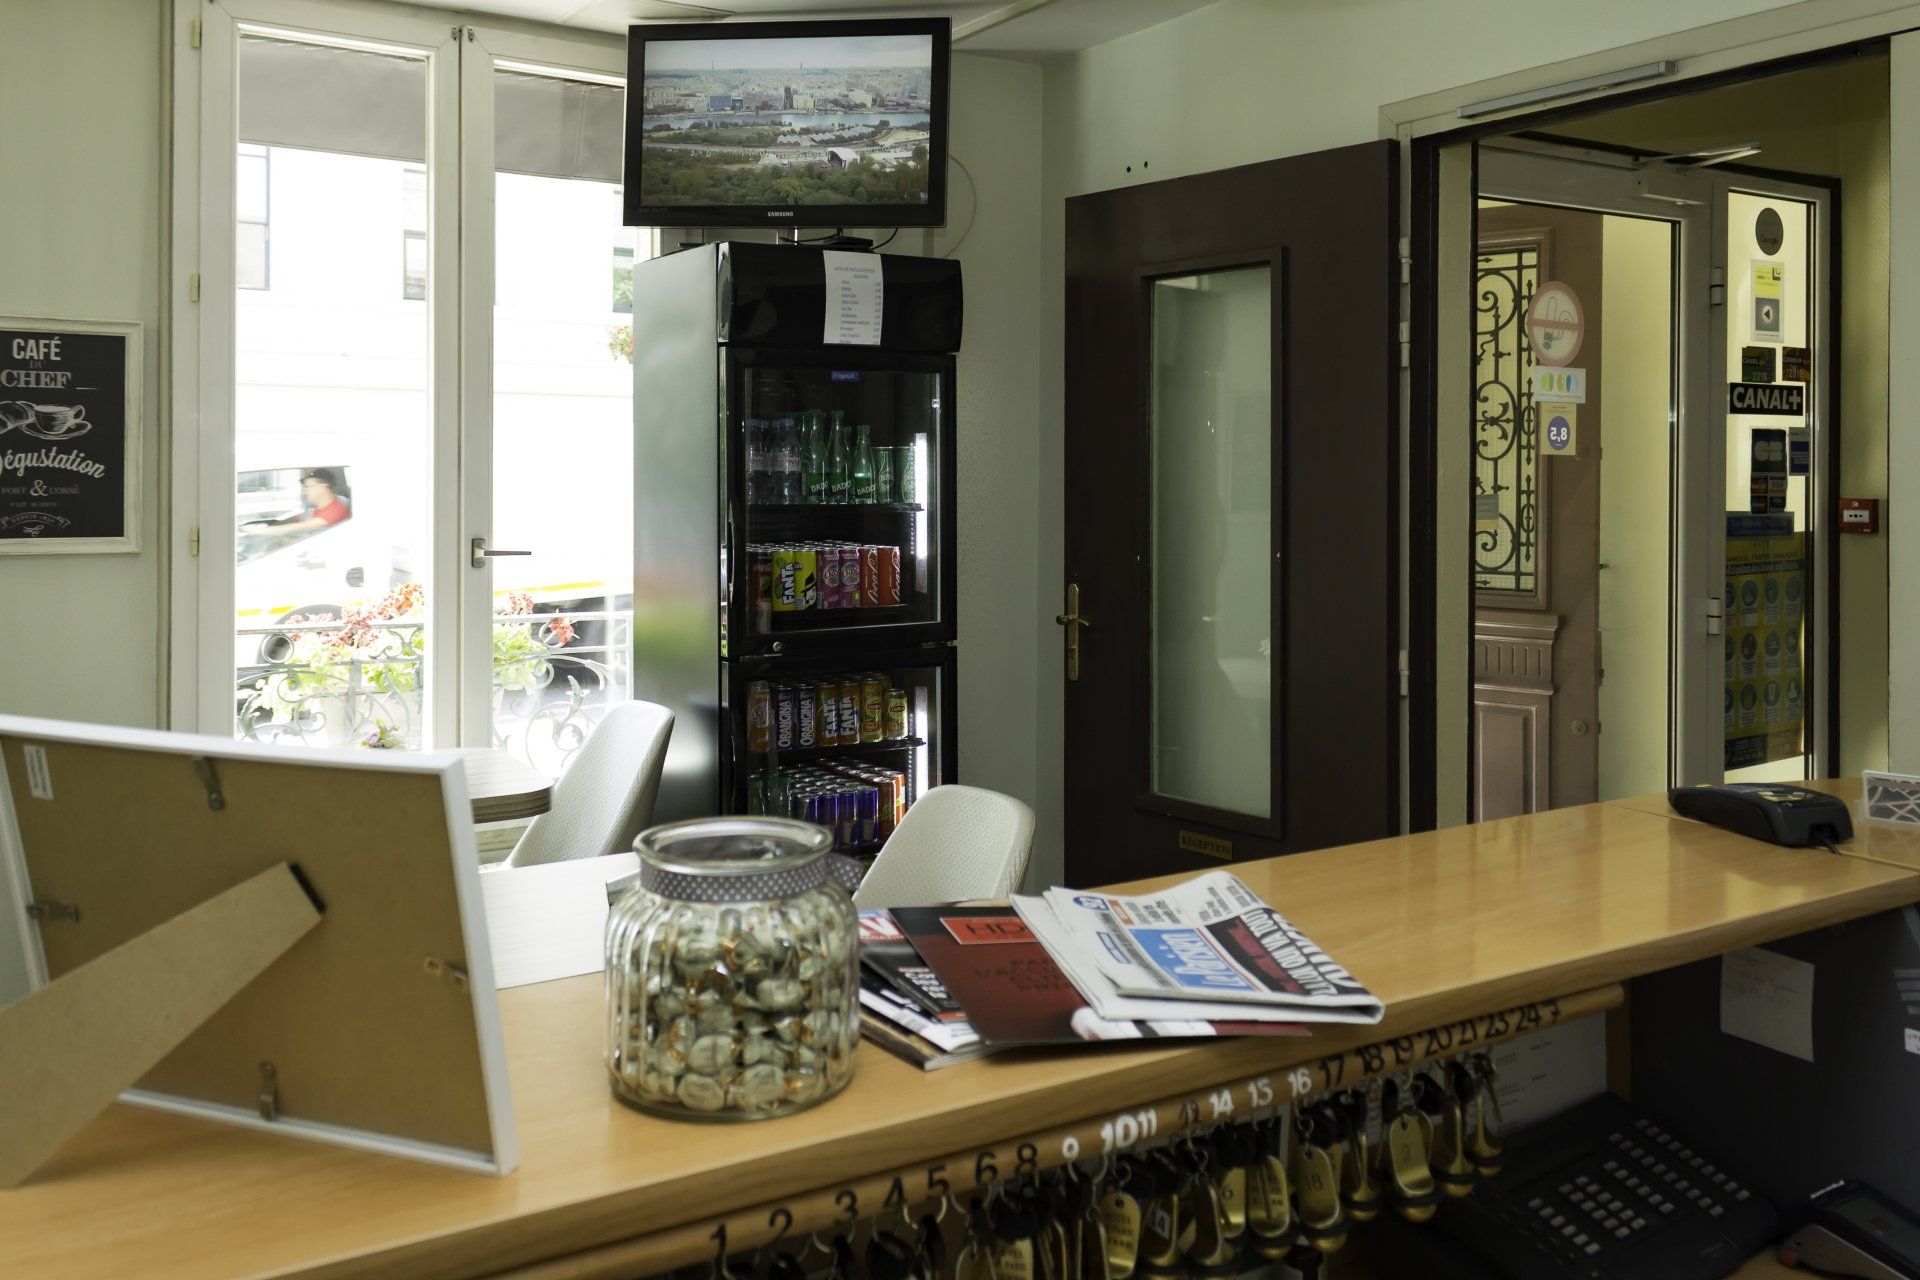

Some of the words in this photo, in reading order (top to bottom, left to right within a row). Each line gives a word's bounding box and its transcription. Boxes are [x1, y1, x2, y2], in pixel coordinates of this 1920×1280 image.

[12, 336, 62, 361] CAFÉ
[0, 369, 72, 389] CHEF
[1733, 386, 1801, 411] CANAL+
[0, 446, 106, 479] égustation
[30, 479, 49, 496] &
[810, 480, 829, 493] BADO
[832, 480, 852, 493] BADO
[857, 484, 876, 496] BADO
[778, 700, 791, 748] ORANGINA
[800, 699, 814, 745] ORANGINA
[823, 697, 838, 739] FANTA
[838, 695, 856, 736] FANTA
[1241, 907, 1271, 938] TOUT
[1262, 932, 1291, 951] VA
[710, 1223, 727, 1258] 1
[769, 1208, 793, 1241] 2
[835, 1190, 859, 1222] 3
[883, 1177, 905, 1210] 4
[926, 1165, 949, 1196] 5
[976, 1152, 998, 1184] 6
[1015, 1143, 1037, 1175] 8
[1100, 1114, 1139, 1152] 10
[1138, 1108, 1157, 1138] 11
[1209, 1088, 1234, 1119] 14
[1248, 1077, 1273, 1107] 15
[1288, 1067, 1312, 1097] 16
[1318, 1053, 1345, 1089] 17
[1355, 1045, 1385, 1075] 18
[1417, 1024, 1453, 1057] 20
[1478, 1011, 1508, 1040] 23
[1509, 1004, 1542, 1032] 24
